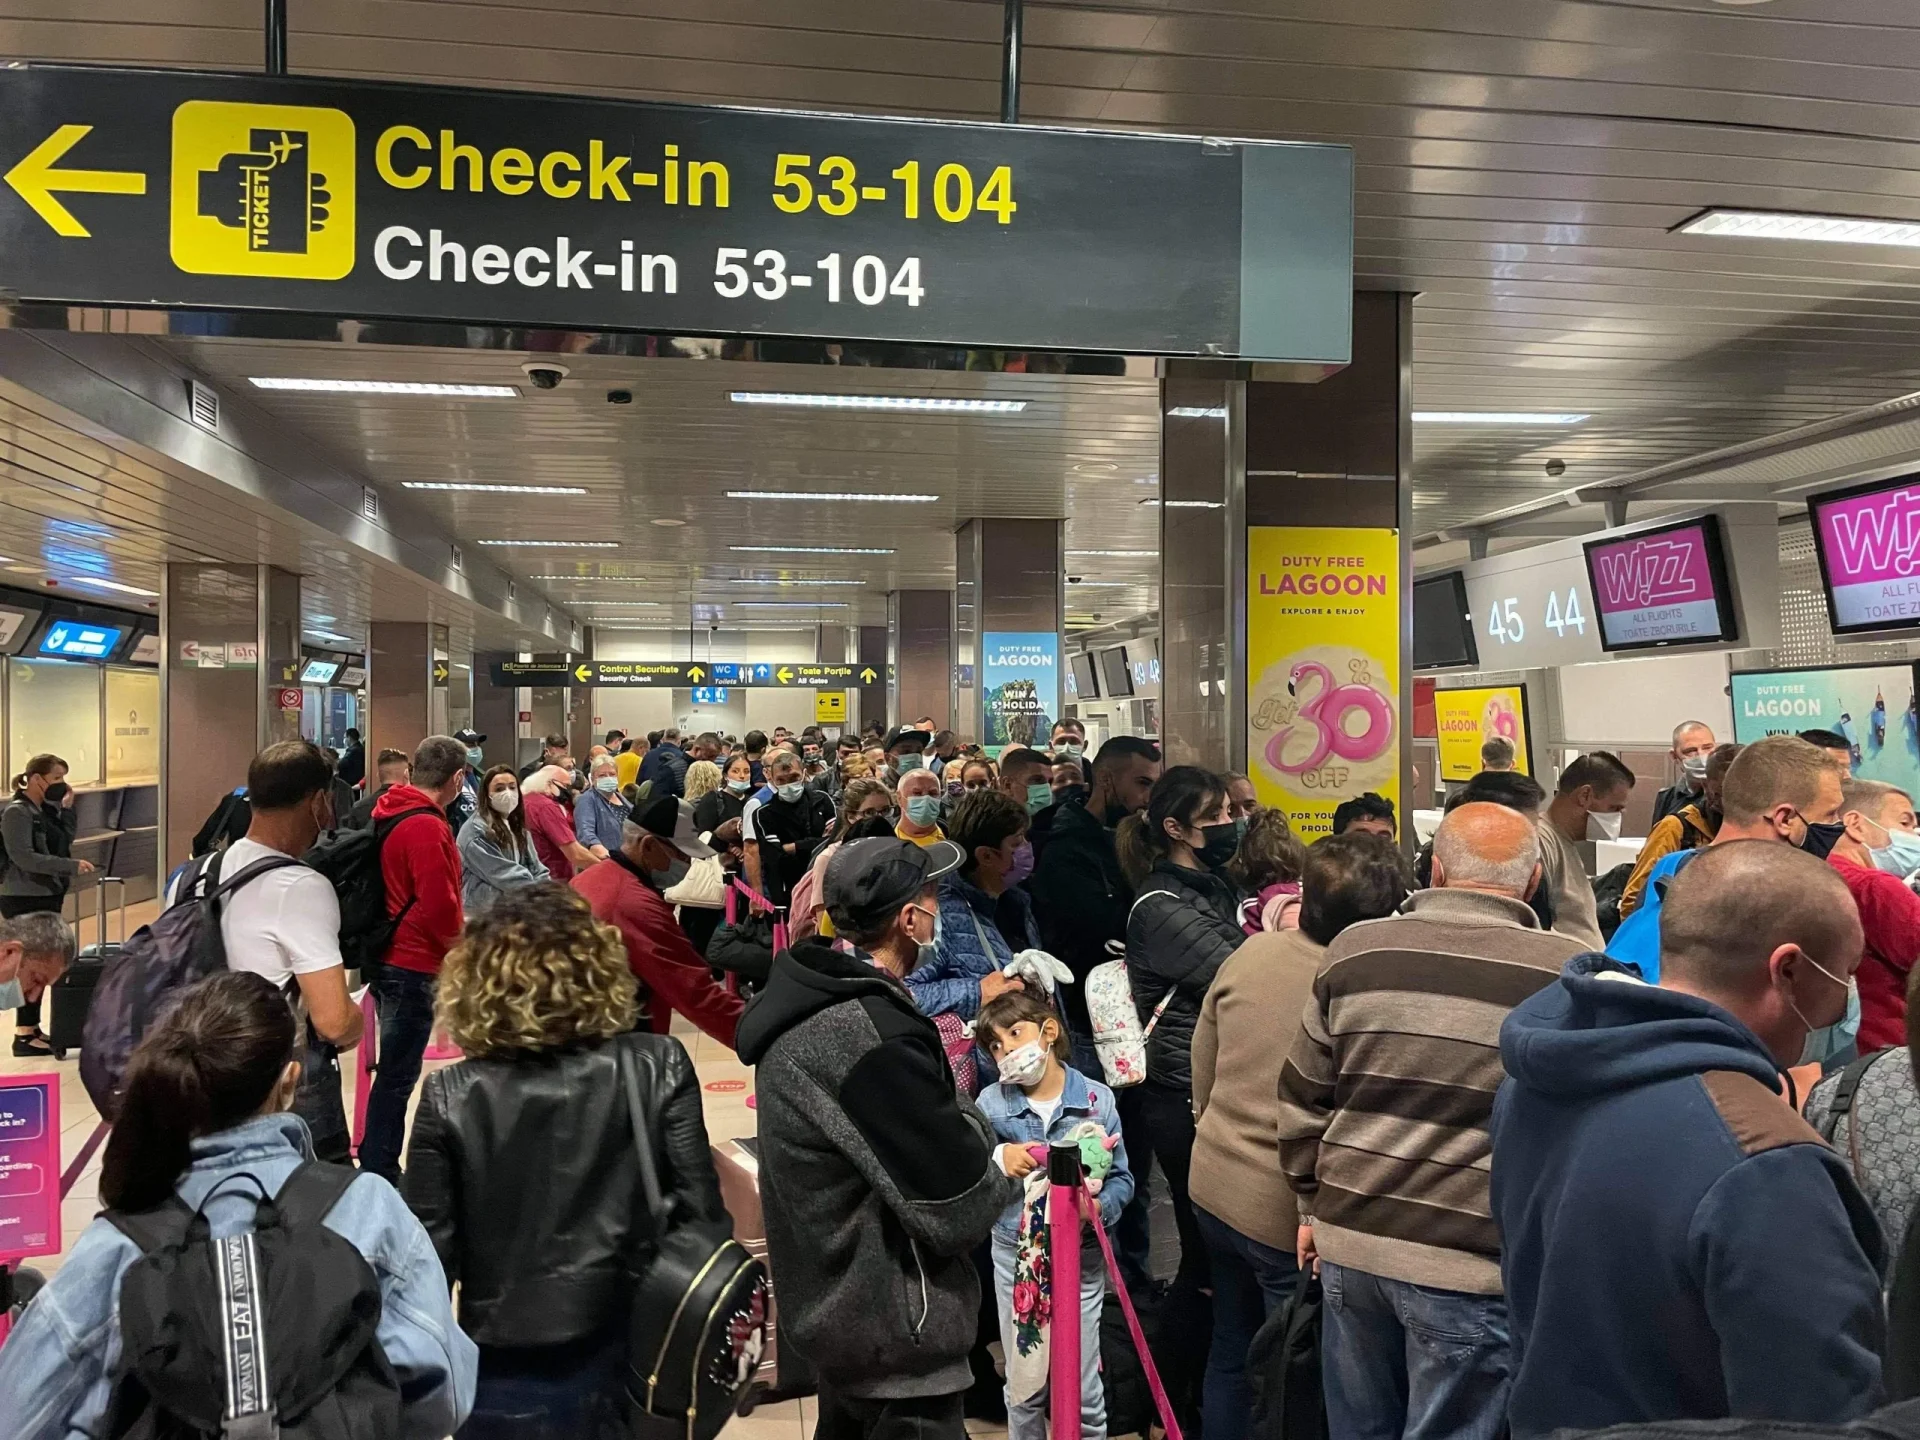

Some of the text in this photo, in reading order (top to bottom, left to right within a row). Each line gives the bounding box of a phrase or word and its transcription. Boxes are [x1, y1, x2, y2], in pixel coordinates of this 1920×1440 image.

[376, 126, 1017, 225] Check-in 53-104
[253, 171, 269, 249] TICKET
[374, 226, 925, 306] Check-in 53-104
[1282, 556, 1365, 568] DUTY FREE
[1260, 573, 1386, 595] LAGOON
[1882, 584, 1905, 598] ALL
[1545, 586, 1585, 638] 44
[1632, 608, 1683, 624] ALL FLIGHTS
[1864, 602, 1907, 618] TOATE
[1488, 597, 1524, 645] 45
[1622, 629, 1648, 639] TOATE
[988, 655, 1053, 666] LAGOON
[599, 664, 679, 673] Control Securitate
[715, 665, 731, 673] WC
[797, 667, 821, 675] Toate
[1134, 662, 1146, 685] 49
[599, 675, 627, 683] Security
[1004, 690, 1037, 698] WIN A
[1757, 684, 1806, 695] DUTY FREE
[1003, 701, 1050, 709] HOLIDAY
[1744, 699, 1822, 717] LAGOON
[1440, 720, 1478, 732] LAGOON
[1301, 766, 1349, 789] OFF
[1291, 812, 1311, 820] FOR
[232, 1301, 252, 1340] EA7
